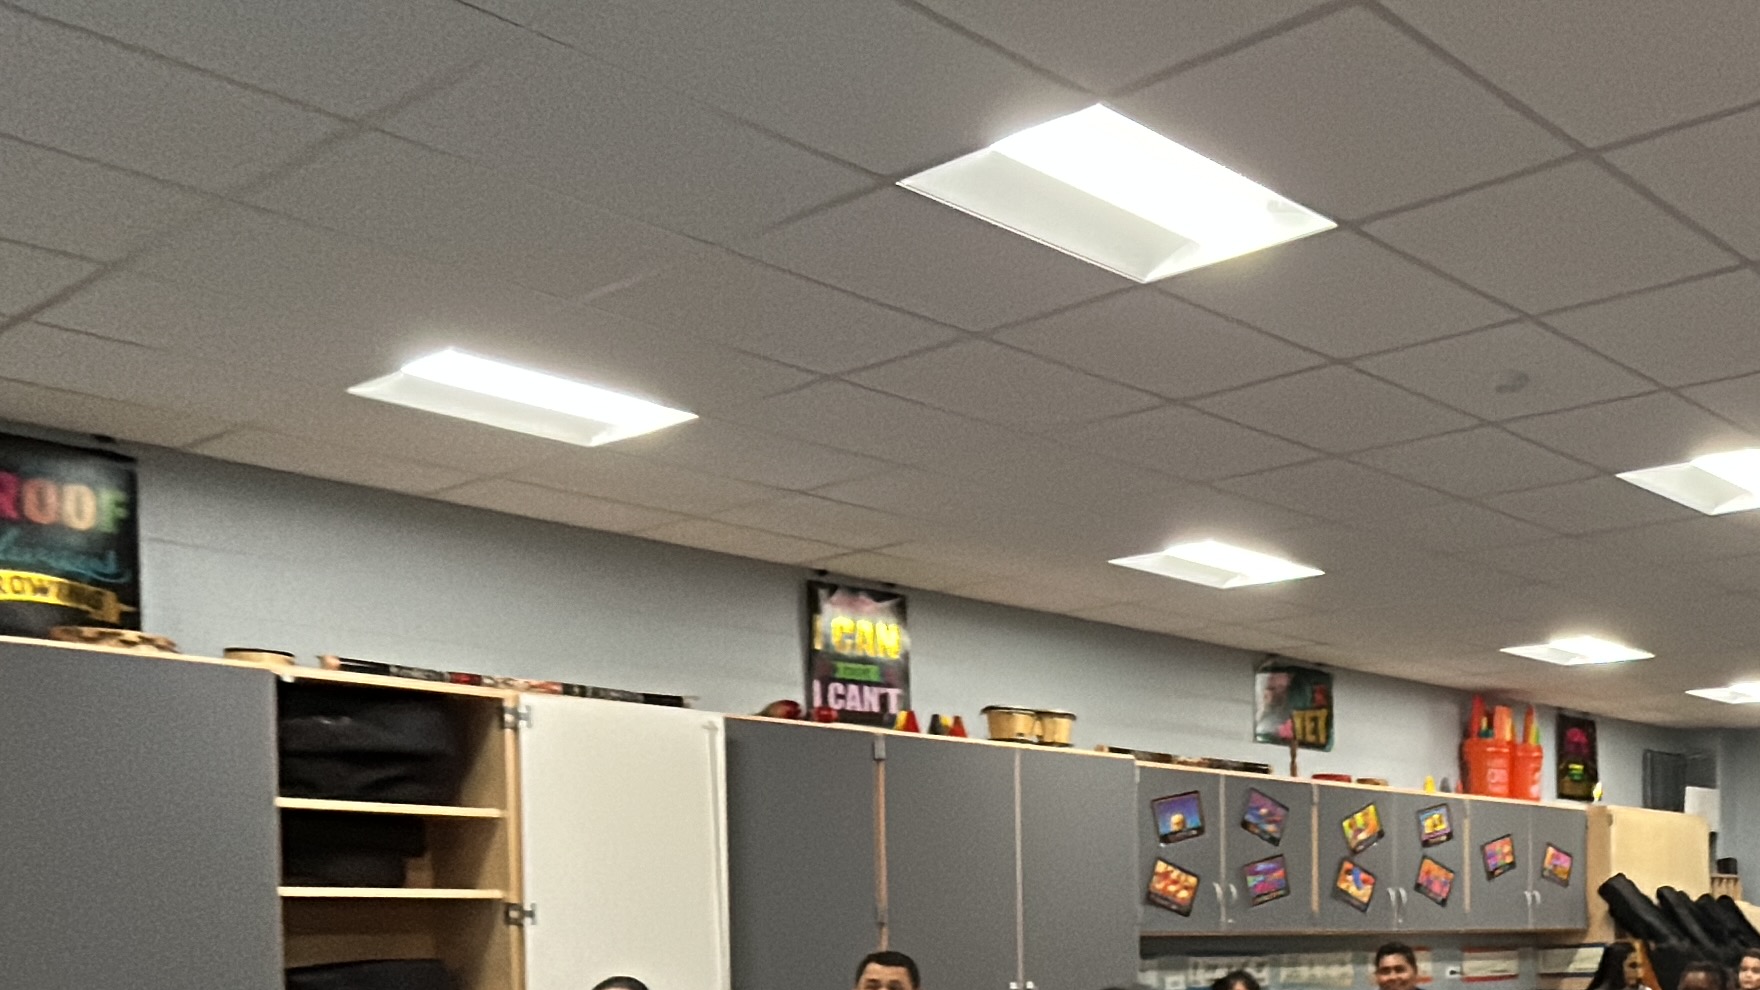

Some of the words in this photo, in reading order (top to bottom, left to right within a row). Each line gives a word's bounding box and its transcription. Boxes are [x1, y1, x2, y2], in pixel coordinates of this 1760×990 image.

[831, 616, 902, 660] CAN
[812, 678, 823, 708] I
[827, 682, 903, 714] CAN'T
